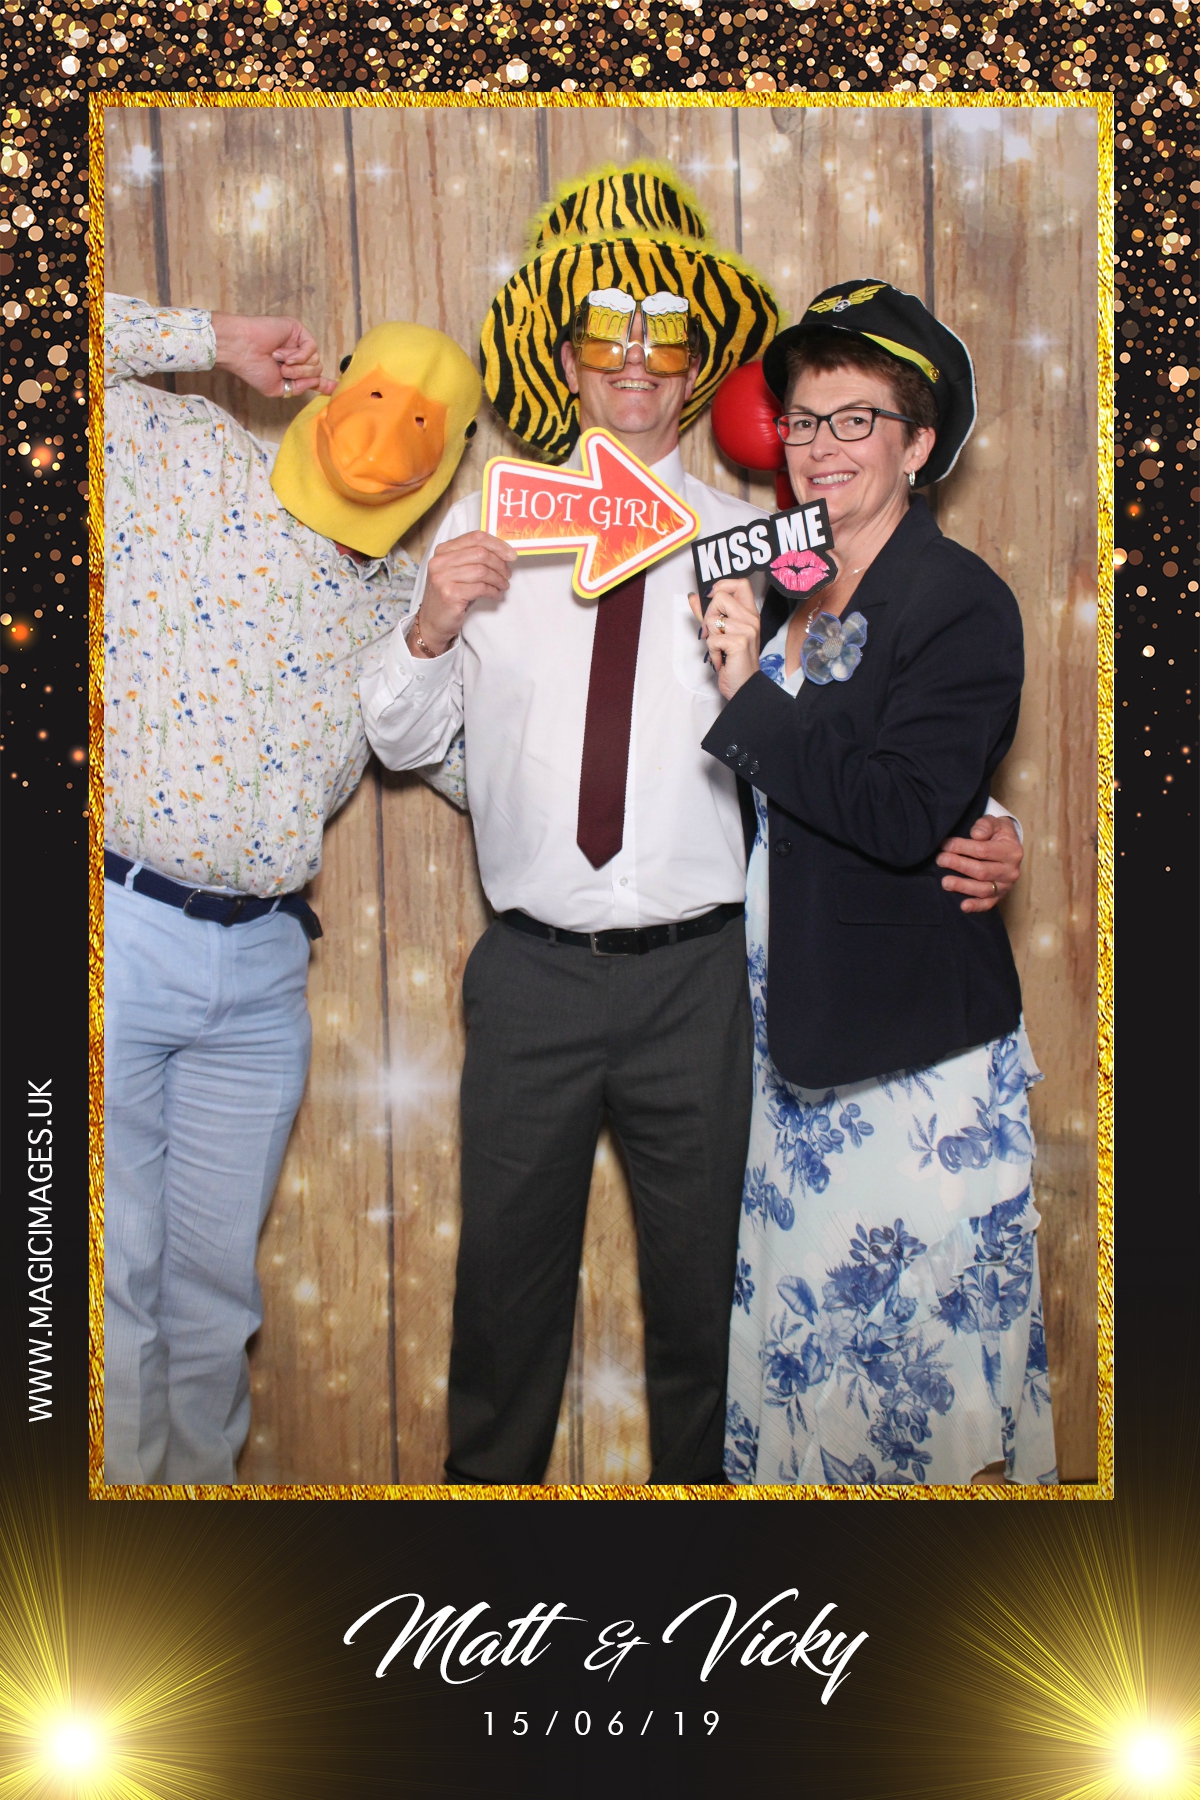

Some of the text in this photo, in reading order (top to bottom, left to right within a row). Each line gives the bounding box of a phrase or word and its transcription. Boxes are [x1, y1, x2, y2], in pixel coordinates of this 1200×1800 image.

[500, 488, 669, 536] HOT GIRL
[697, 505, 826, 583] KISS ME
